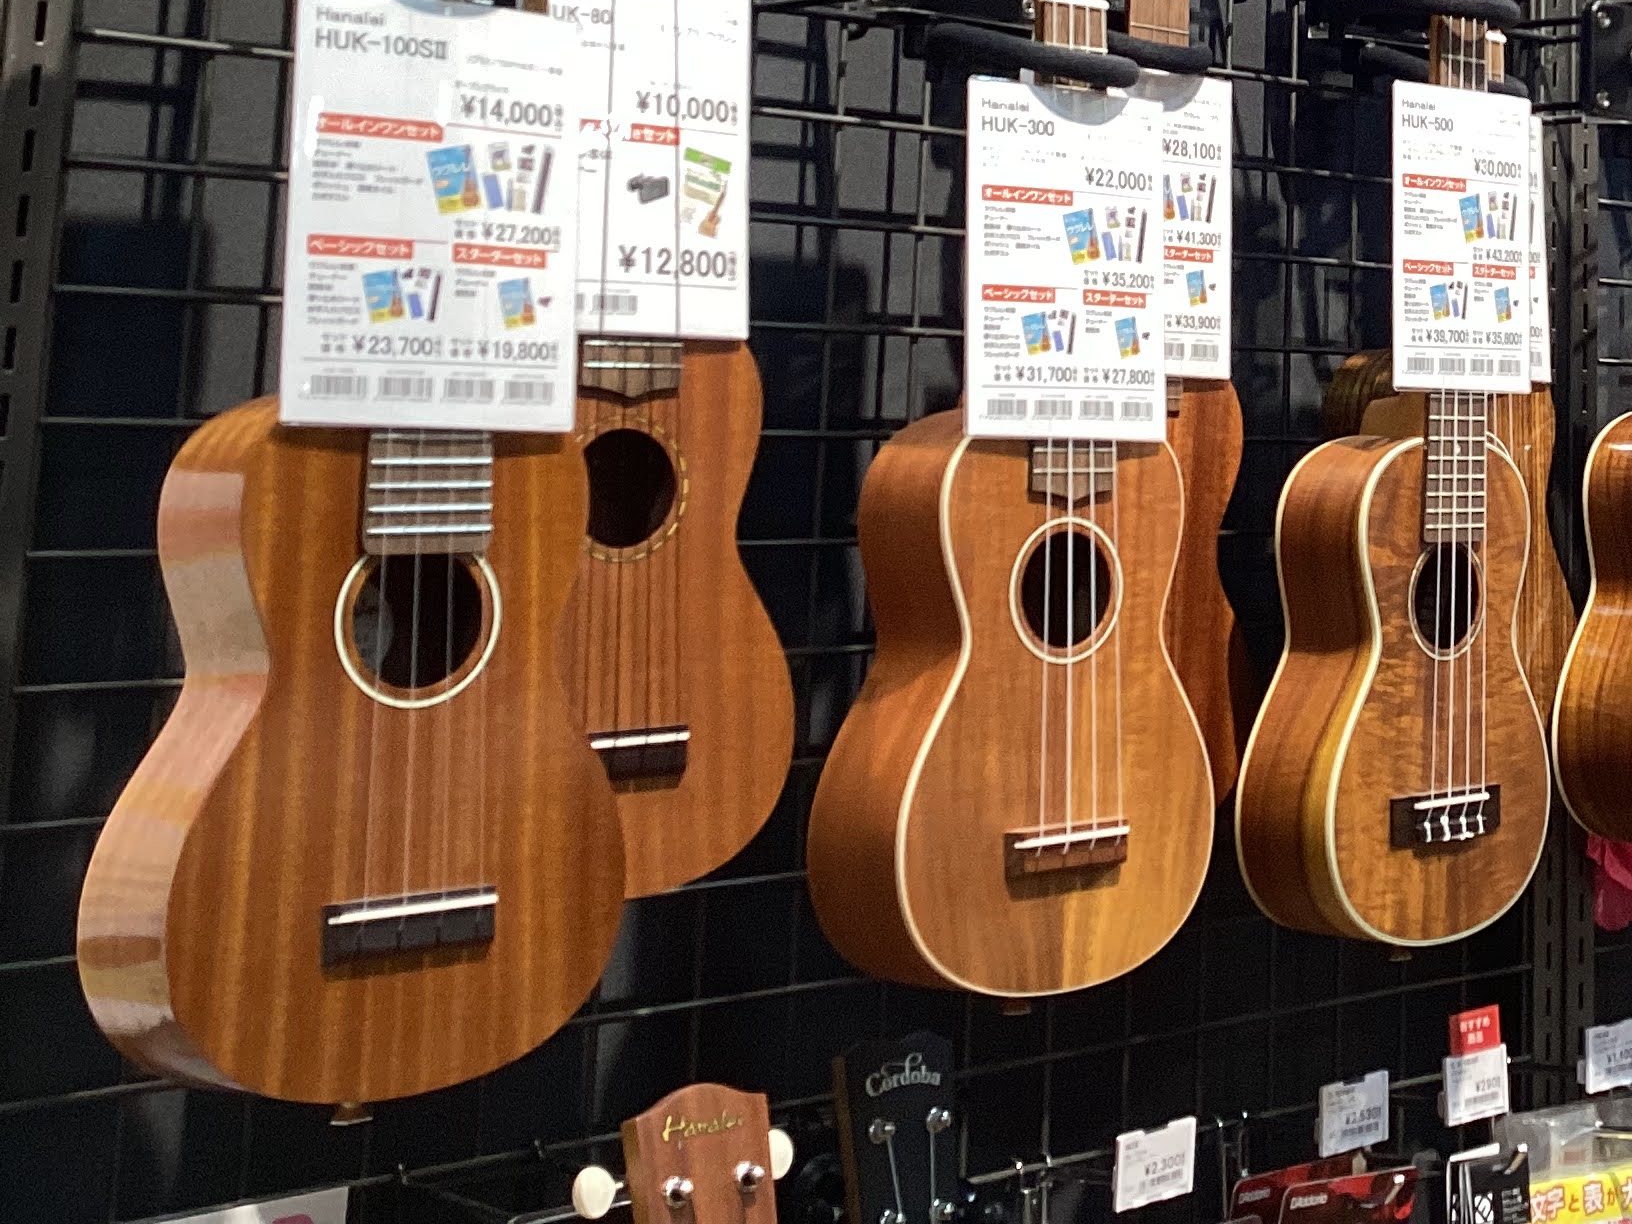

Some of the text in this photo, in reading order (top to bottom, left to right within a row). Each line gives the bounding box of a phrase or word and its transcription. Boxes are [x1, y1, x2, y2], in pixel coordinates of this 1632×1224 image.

[315, 6, 386, 26] Hanalei
[461, 93, 552, 126] ¥14,000
[636, 90, 730, 123] ¥10,000
[981, 98, 1030, 113] Hanalei
[981, 116, 1054, 137] HUK-300
[1402, 114, 1453, 132] HUK-500
[1162, 138, 1216, 161] ¥28,100
[1085, 166, 1146, 192] ¥22,000
[1403, 175, 1466, 190] オールインワンセット
[984, 187, 1072, 205] オールインワンセット
[482, 222, 551, 246] ¥27,200
[310, 238, 411, 257] ベーシックセット
[619, 245, 728, 279] ¥12,800
[1404, 261, 1452, 274] ベーシックセット
[1102, 271, 1150, 289] ¥35,200
[1474, 266, 1515, 278] スターターセット
[984, 287, 1053, 302] ベーシックセット
[1085, 291, 1144, 305] スターターセット
[352, 336, 433, 356] ¥23,700
[480, 340, 550, 361] ¥19,800
[1016, 365, 1073, 384] ¥31,700
[1102, 368, 1150, 385] ¥27,800
